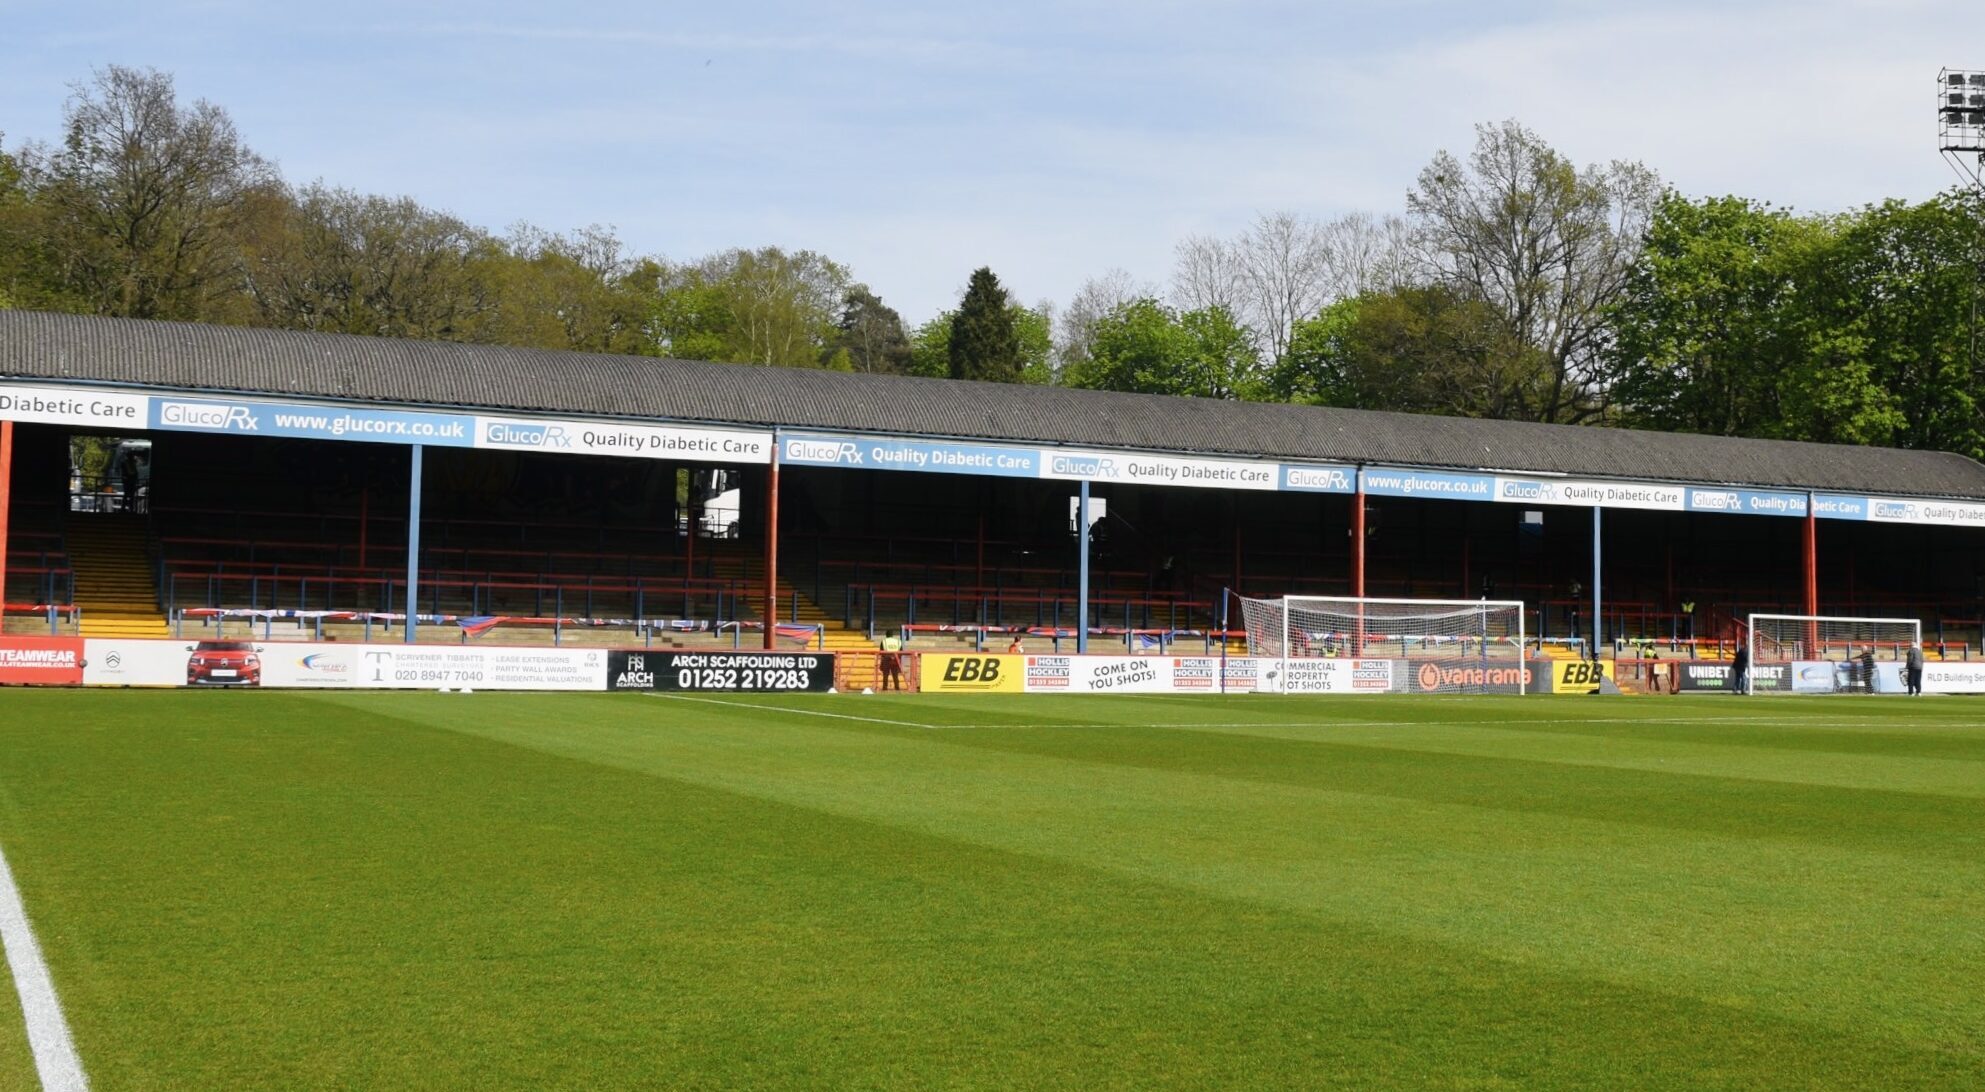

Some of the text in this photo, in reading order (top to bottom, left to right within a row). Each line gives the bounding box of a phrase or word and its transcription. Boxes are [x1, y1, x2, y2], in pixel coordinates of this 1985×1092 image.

[0, 395, 136, 418] Diabetic Care
[275, 413, 464, 438] www.glucorx.co.uk
[583, 431, 645, 451] Quality
[650, 435, 718, 452] Diabetic
[723, 439, 760, 454] Care
[872, 447, 929, 467] Quality
[932, 450, 993, 467] Diabetic
[997, 454, 1031, 469] Care
[1128, 463, 1177, 480] Quality
[1182, 466, 1236, 480] Diabetic
[1240, 469, 1270, 482] Care
[1368, 475, 1488, 494] www.glucorx.co.uk
[1564, 486, 1604, 503] Quality
[1608, 488, 1651, 502] Diabetic
[1654, 491, 1678, 503] Care
[1750, 496, 1788, 512] Quality
[1838, 502, 1860, 513] Care
[1924, 507, 1956, 520] Quality
[0, 649, 75, 662] TEAMWEAR
[521, 656, 570, 664] EXTENSIONS
[671, 655, 818, 669] ARCH SCAFFOLDING LTD
[1038, 657, 1069, 666] HOLLIS
[495, 665, 520, 673] PARTY
[943, 658, 1000, 681] EBB
[1094, 659, 1148, 677] COME ON
[1182, 659, 1212, 668] HOLLIS
[1228, 660, 1257, 668] HOLLIS
[1361, 661, 1388, 669] HOLLIS
[395, 670, 483, 681] 020 8947 7040
[617, 671, 654, 683] ARCH
[1028, 668, 1069, 676] HOCKLEY
[1174, 669, 1212, 677] HOCKLEY
[1285, 671, 1328, 680] ROPERTY
[1353, 670, 1388, 679] HOCKLEY
[1440, 668, 1532, 684] vanarama
[1562, 663, 1604, 684] EBB
[1689, 666, 1730, 678] UNIBET
[1927, 673, 1942, 682] RLD
[1944, 673, 1973, 684] Building
[678, 669, 810, 689] 01252 219283
[1088, 670, 1156, 690] YOU SHOTS!
[1302, 680, 1332, 690] SHOTS
